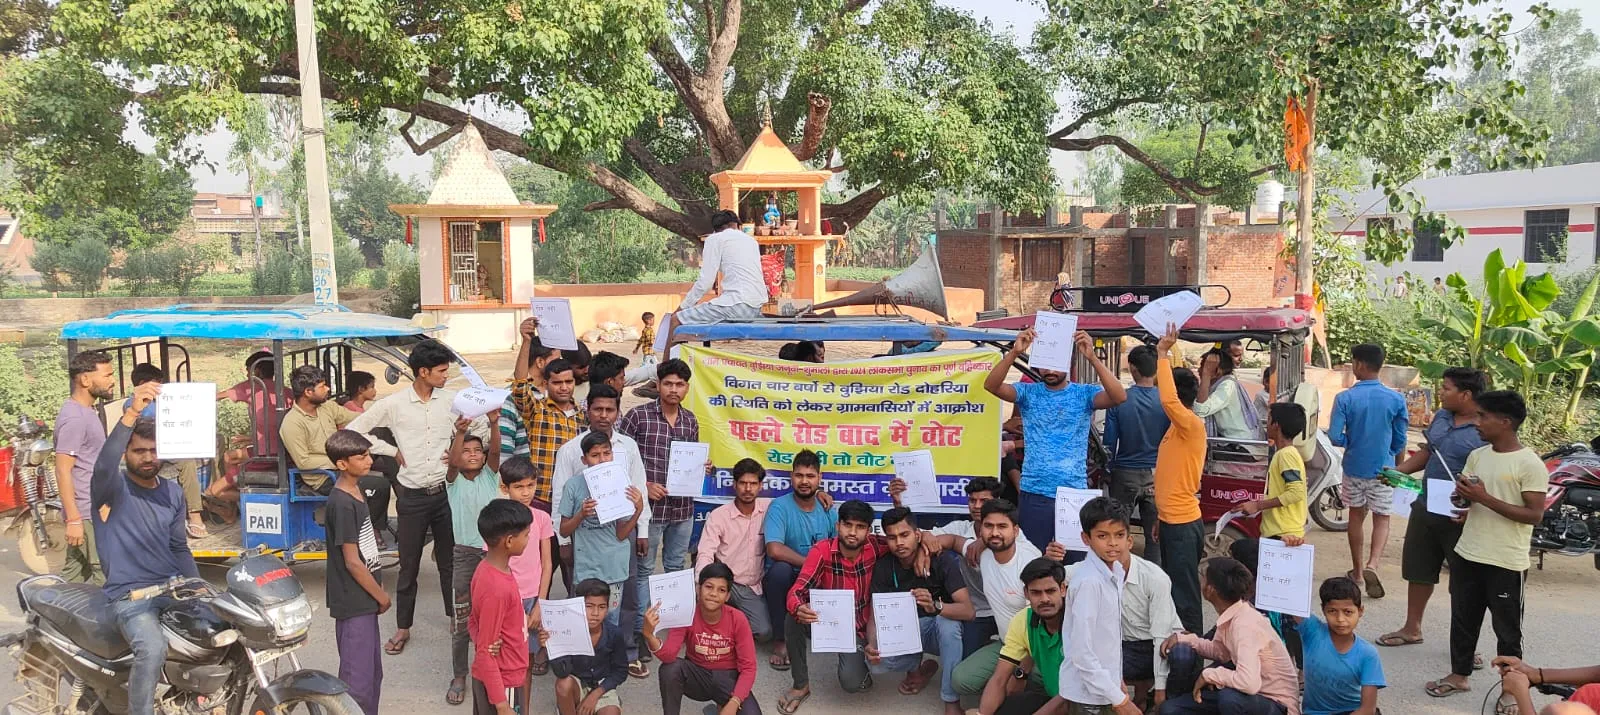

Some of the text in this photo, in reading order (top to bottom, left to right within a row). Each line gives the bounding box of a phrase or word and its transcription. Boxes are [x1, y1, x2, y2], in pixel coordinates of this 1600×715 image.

[1099, 292, 1150, 307] UNIQUE
[930, 364, 941, 372] का
[724, 376, 762, 390] विगत
[766, 380, 791, 392] चार
[822, 381, 836, 393] से
[888, 382, 911, 395] रोड
[915, 380, 969, 394] दोहरिया
[708, 394, 727, 407] की
[773, 398, 792, 411] को
[796, 399, 832, 412] लेकर
[836, 400, 916, 414] ग्रामवासियों
[917, 400, 932, 413] में
[934, 400, 985, 414] आक्रोश
[728, 416, 784, 442] पहले
[792, 417, 830, 445] रोड
[888, 420, 914, 447] में
[920, 420, 964, 447] वोट
[766, 448, 794, 464] रोड
[832, 452, 852, 466] तो
[856, 452, 887, 467] वोट
[250, 515, 278, 530] PARI
